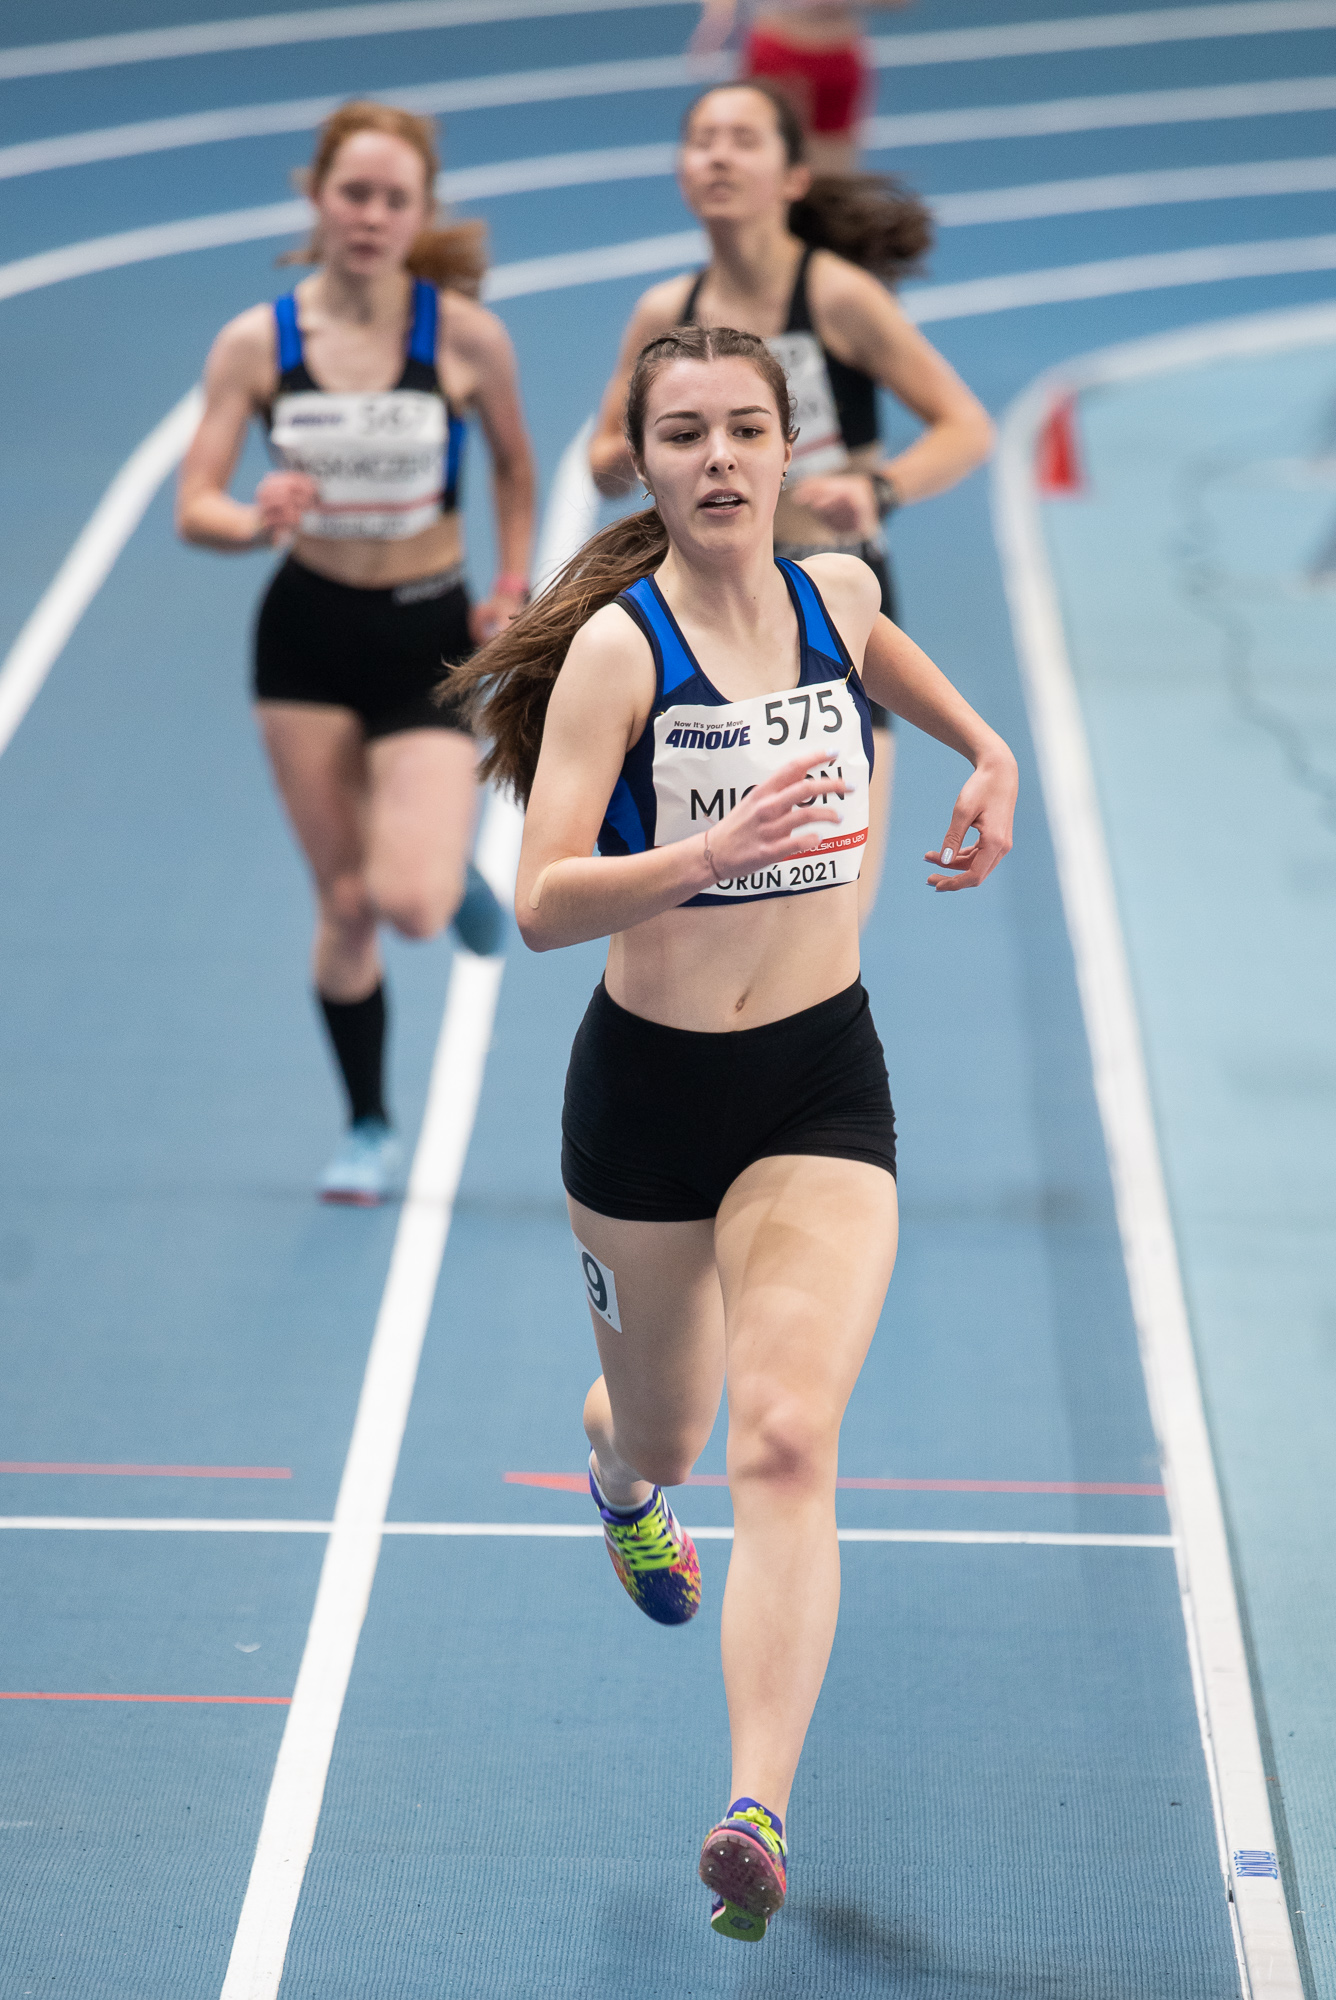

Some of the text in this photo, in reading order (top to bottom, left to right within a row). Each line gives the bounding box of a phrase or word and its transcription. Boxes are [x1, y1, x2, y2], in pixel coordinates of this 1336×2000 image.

[693, 721, 704, 729] It's
[706, 723, 725, 731] your
[725, 720, 744, 728] Move
[765, 689, 843, 746] 575
[664, 725, 751, 750] 4MOVE
[836, 838, 851, 847] U18
[852, 834, 865, 843] U20
[789, 860, 837, 887] 2021
